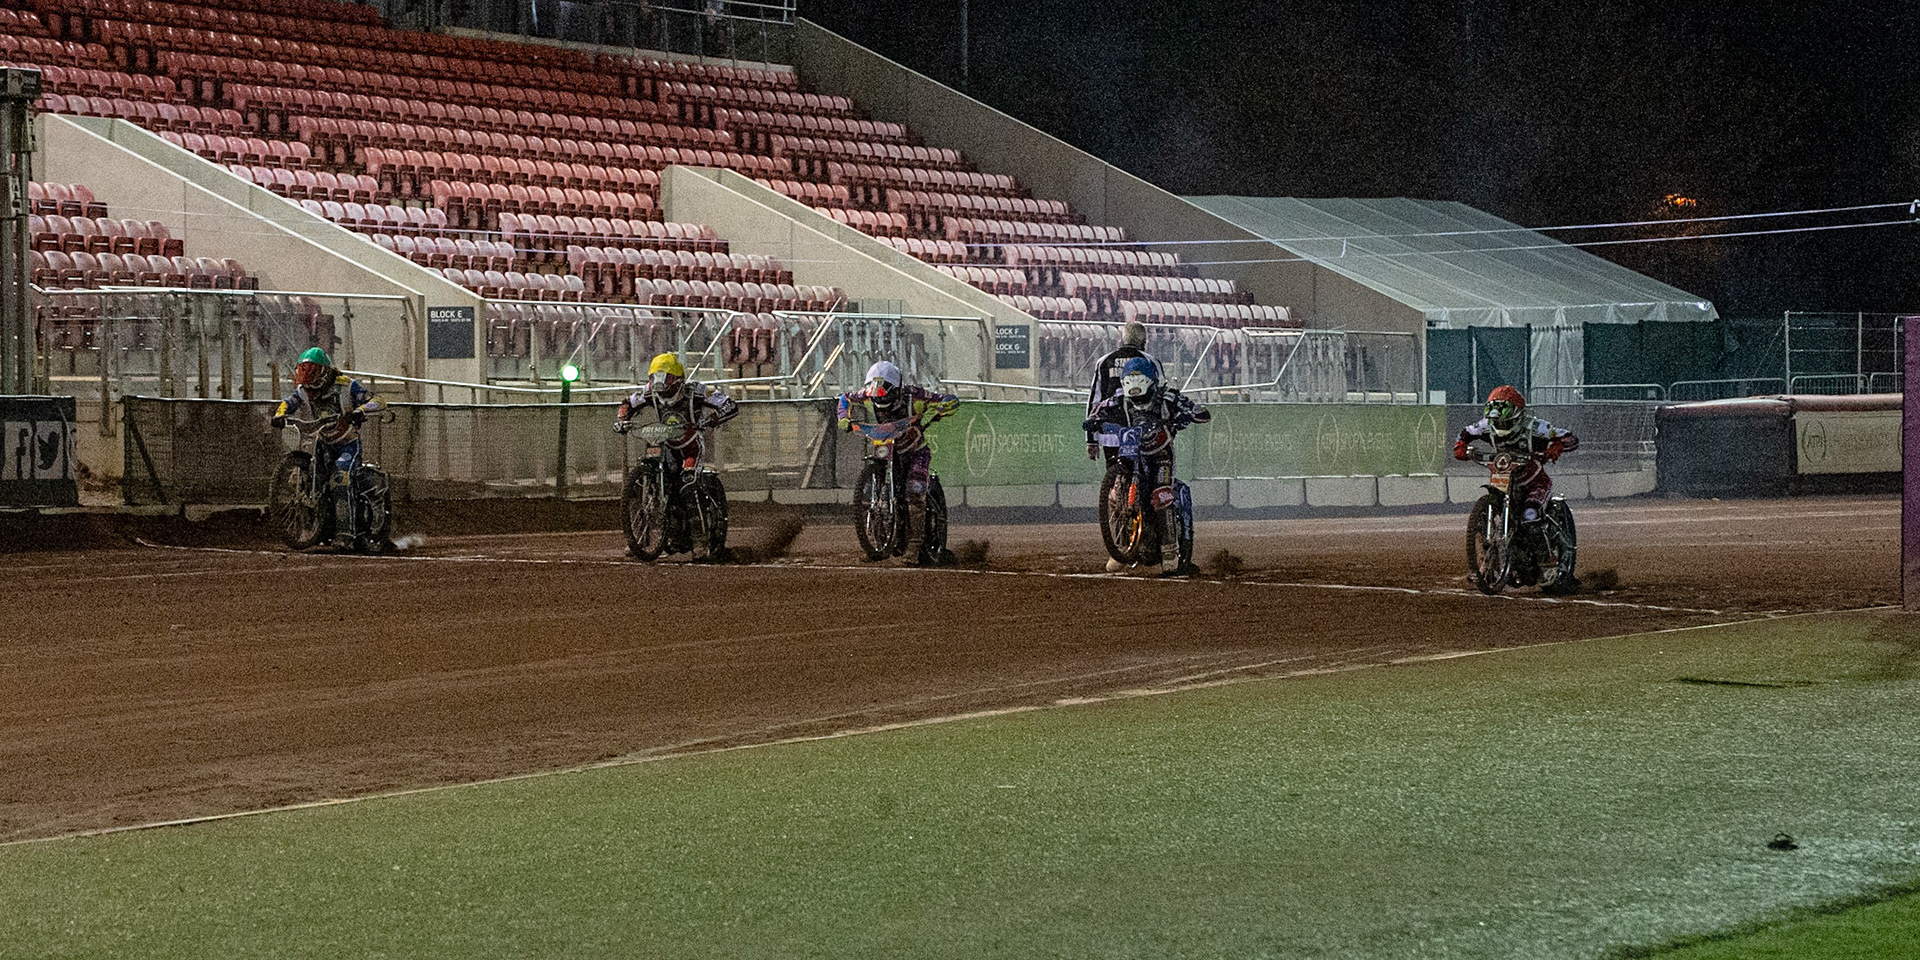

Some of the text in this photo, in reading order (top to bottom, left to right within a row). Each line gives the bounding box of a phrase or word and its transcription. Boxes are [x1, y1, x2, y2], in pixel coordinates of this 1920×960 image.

[430, 310, 463, 318] BLOCK E
[997, 433, 1030, 453] SPORTS
[1031, 433, 1064, 453] EVENTS
